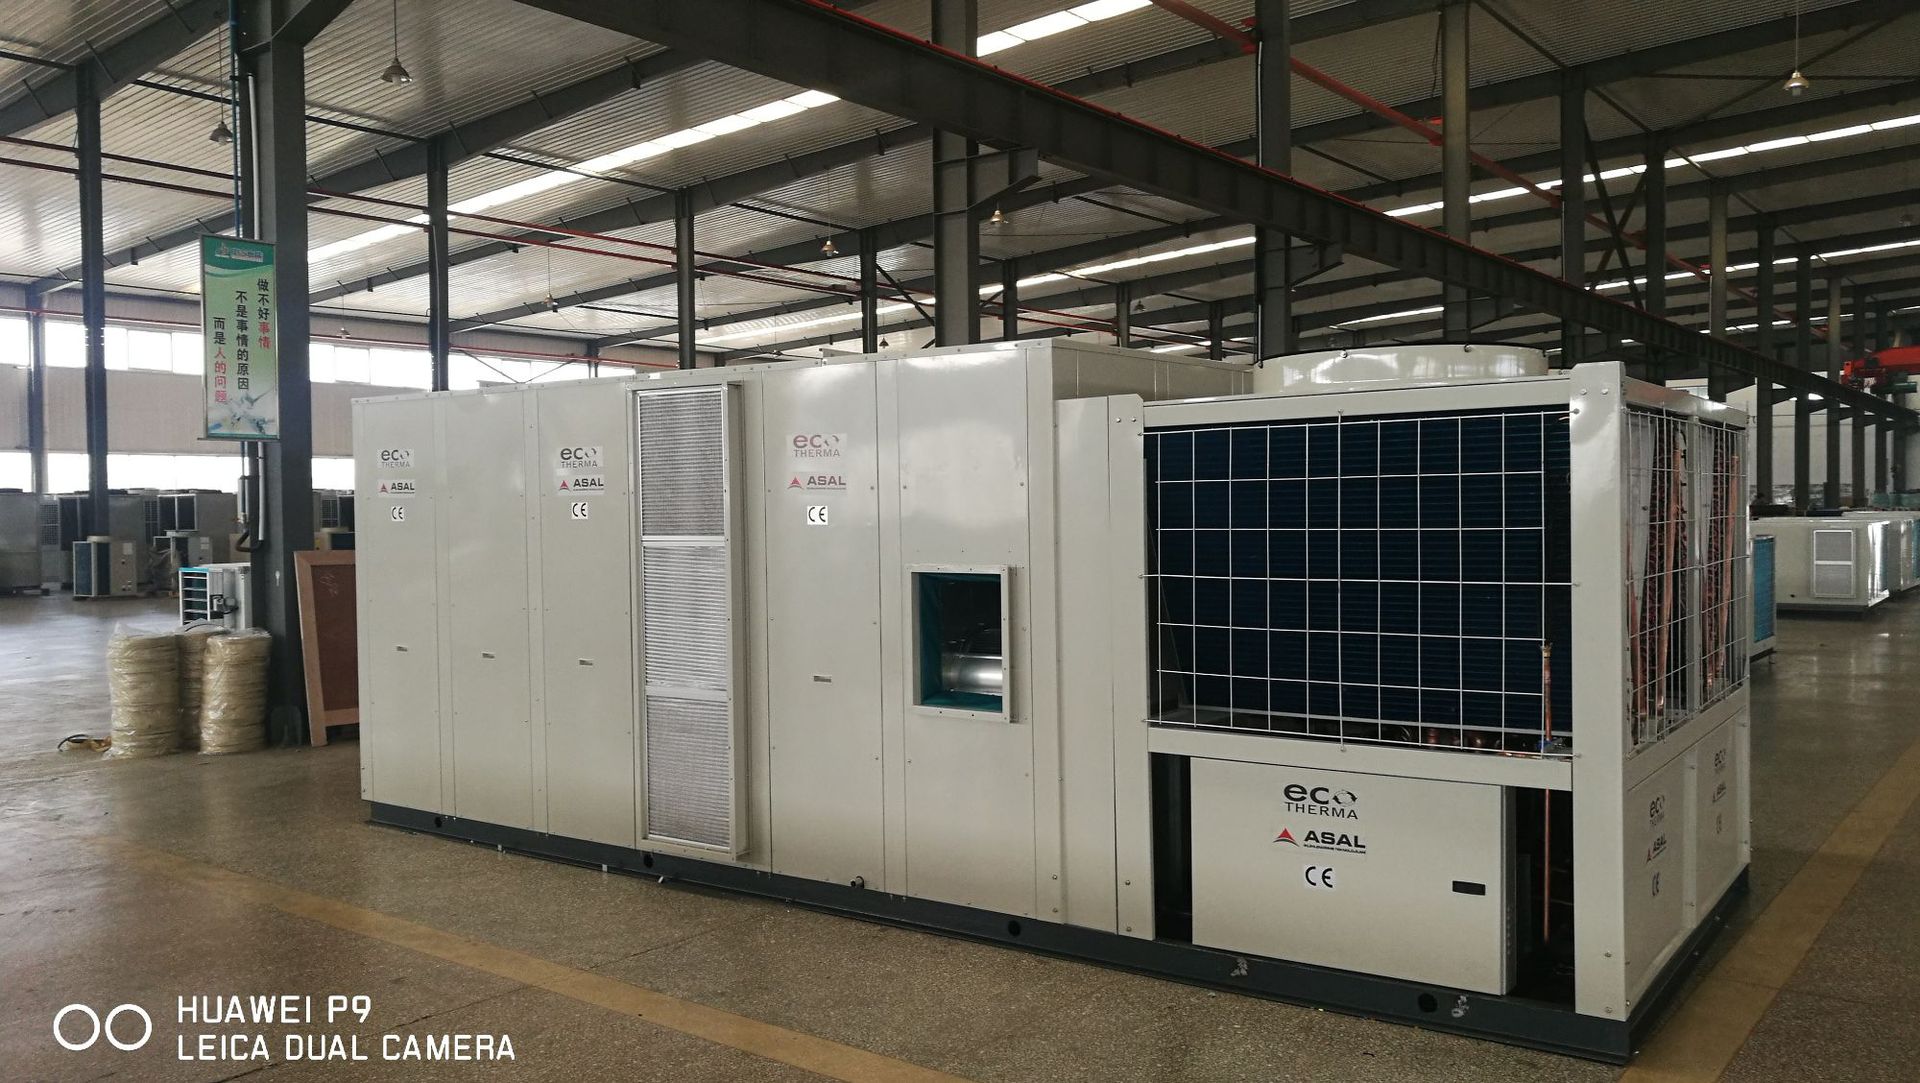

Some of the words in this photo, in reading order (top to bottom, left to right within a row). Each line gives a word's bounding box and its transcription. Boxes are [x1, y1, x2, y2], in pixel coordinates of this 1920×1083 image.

[257, 278, 272, 349] 做不好事情
[235, 290, 249, 390] 不是事情的原因
[212, 316, 228, 403] 而是人的问题
[793, 449, 841, 458] THERMA
[381, 461, 411, 469] THERMA
[561, 460, 598, 469] THERMA
[391, 482, 415, 491] ASAL
[573, 477, 604, 488] ASAL
[806, 475, 847, 486] ASAL
[391, 506, 404, 520] CE
[572, 502, 587, 518] CE
[808, 506, 826, 522] CE
[1284, 784, 1358, 807] eco
[1284, 801, 1359, 820] THERMA
[1303, 829, 1366, 849] ASAL
[1305, 866, 1334, 888] CE
